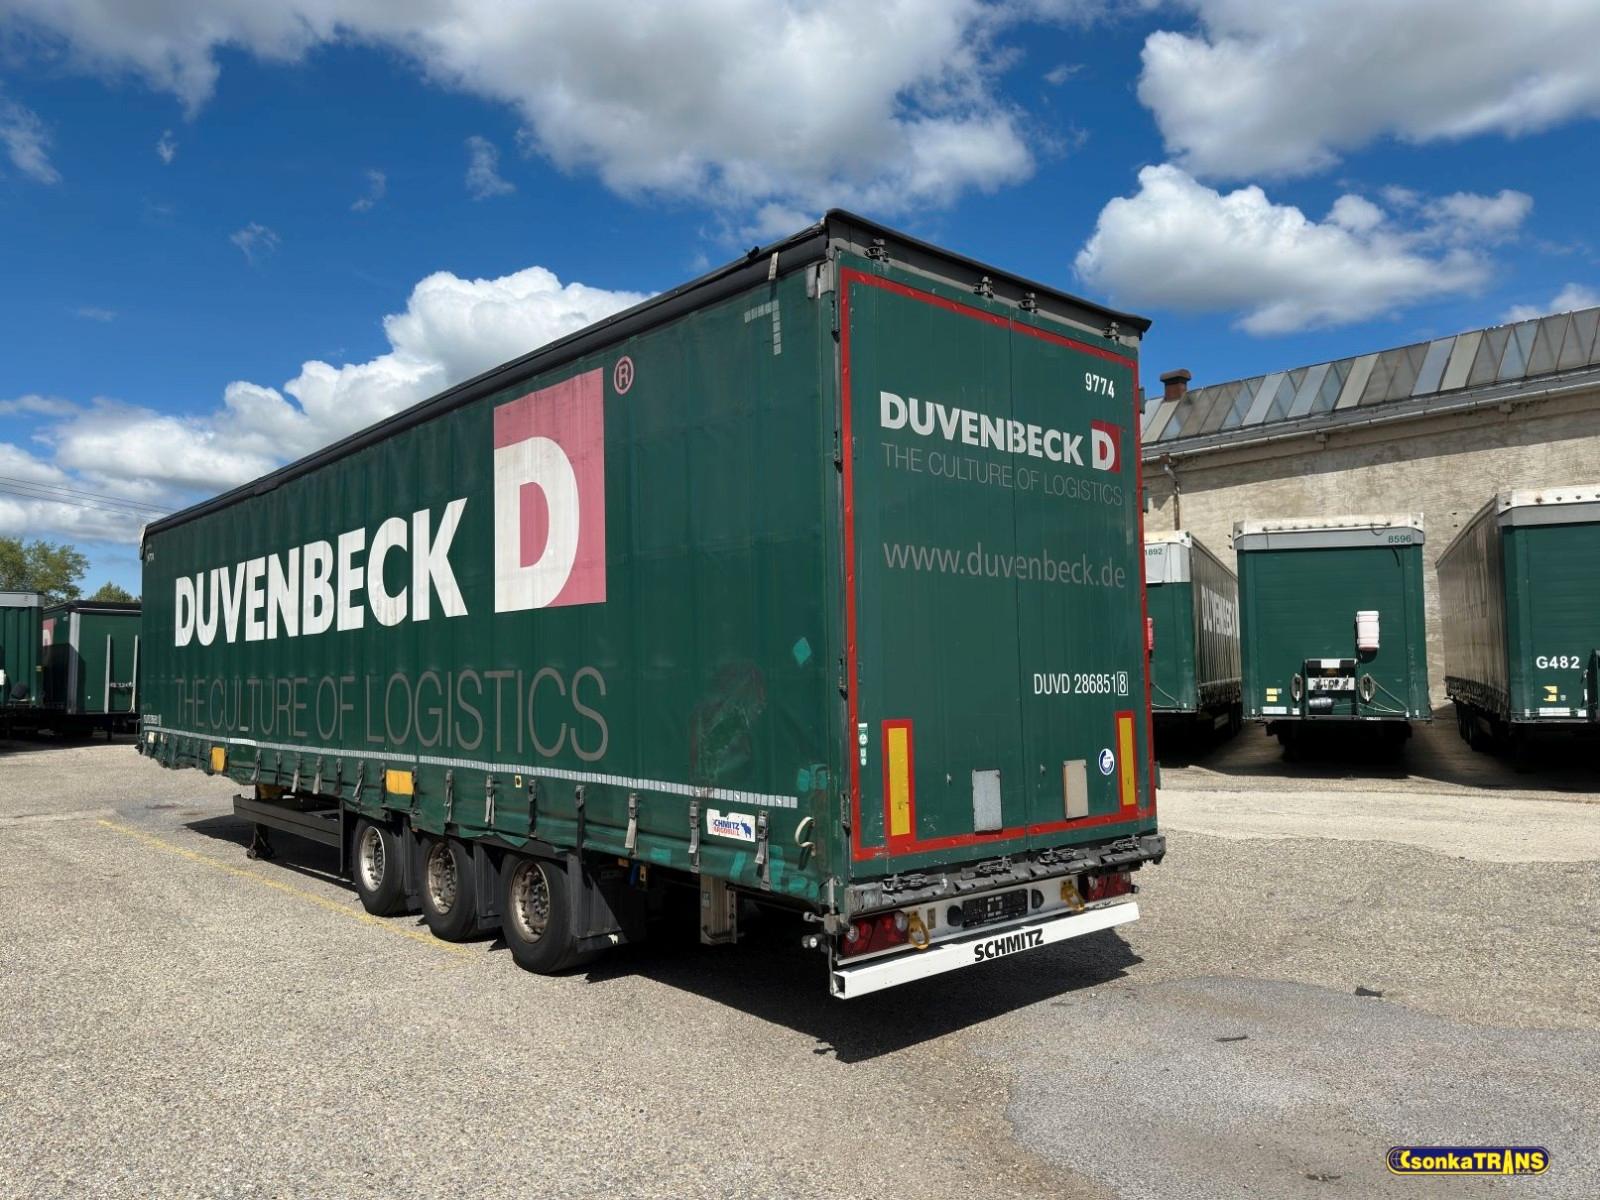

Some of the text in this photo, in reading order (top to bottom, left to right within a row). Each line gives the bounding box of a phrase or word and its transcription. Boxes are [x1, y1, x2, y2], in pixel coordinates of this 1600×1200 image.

[1085, 372, 1115, 399] 9774
[880, 391, 1115, 471] DUVENBECK D
[881, 442, 1123, 506] THE CULTURE OF LOGISTICS
[175, 437, 581, 647] DUVENBECK D
[1388, 534, 1411, 544] 8596
[883, 542, 1127, 588] www.duvenbeck.de
[1536, 655, 1580, 669] G482
[1034, 673, 1070, 695] DUVD
[176, 666, 609, 761] THE CULTURE OF LOGISTICS
[974, 928, 1044, 962] SCHMITZ
